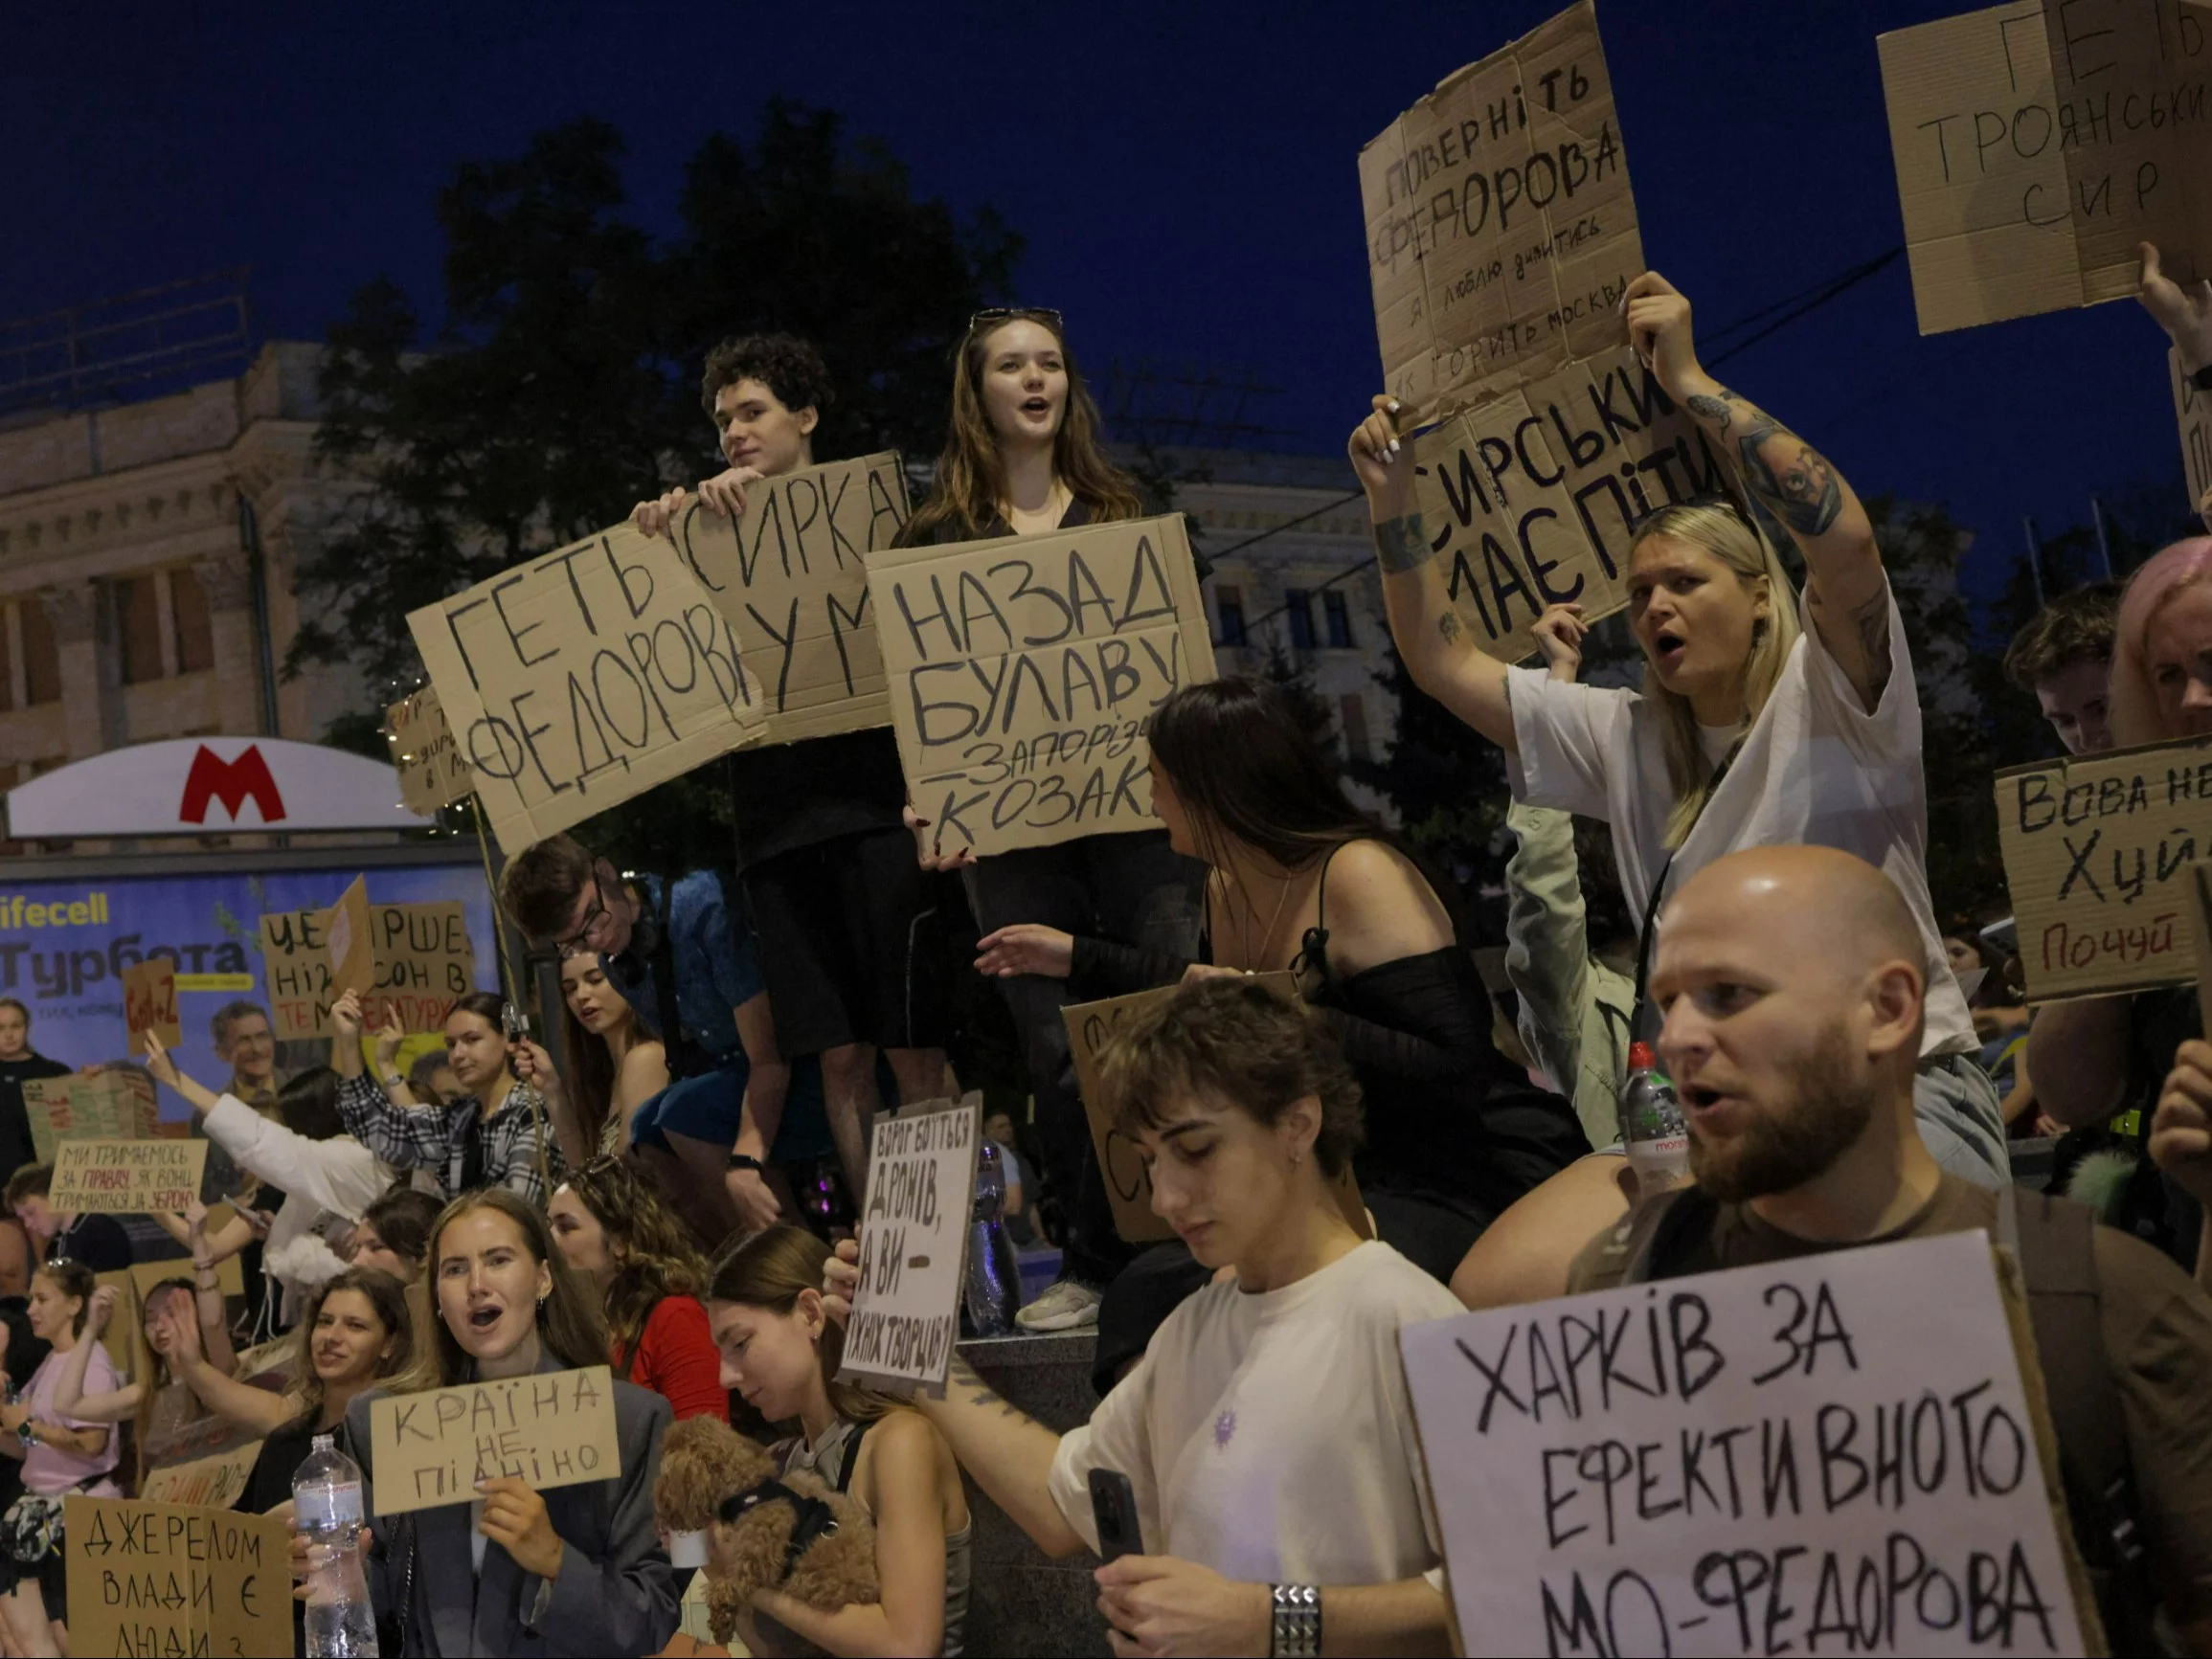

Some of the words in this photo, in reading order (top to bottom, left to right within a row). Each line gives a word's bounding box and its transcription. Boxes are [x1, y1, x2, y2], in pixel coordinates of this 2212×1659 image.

[2023, 161, 2158, 226] СИР
[1547, 275, 1628, 333] МОСКВА
[446, 535, 654, 693] ГЕТЬ
[893, 534, 1180, 661] НАЗАД
[909, 630, 1179, 747] БУЛАВУ
[266, 911, 327, 955] ЦЕ
[446, 962, 466, 995] В
[876, 1122, 913, 1158] ВОРОГ
[858, 1228, 873, 1293] А
[876, 1226, 907, 1296] ВИ
[1456, 1288, 1726, 1434] ХАРКІВ
[1753, 1282, 1859, 1386] ЗА
[395, 1370, 601, 1447] КРАЇНА
[475, 1428, 528, 1464] НЕ
[1542, 1379, 2026, 1549] ЕФЕКТИВНОГО
[83, 1509, 261, 1568] ДЖЕРЕЛОМ
[102, 1569, 214, 1615] ВЛАДИ
[241, 1573, 261, 1618] Є
